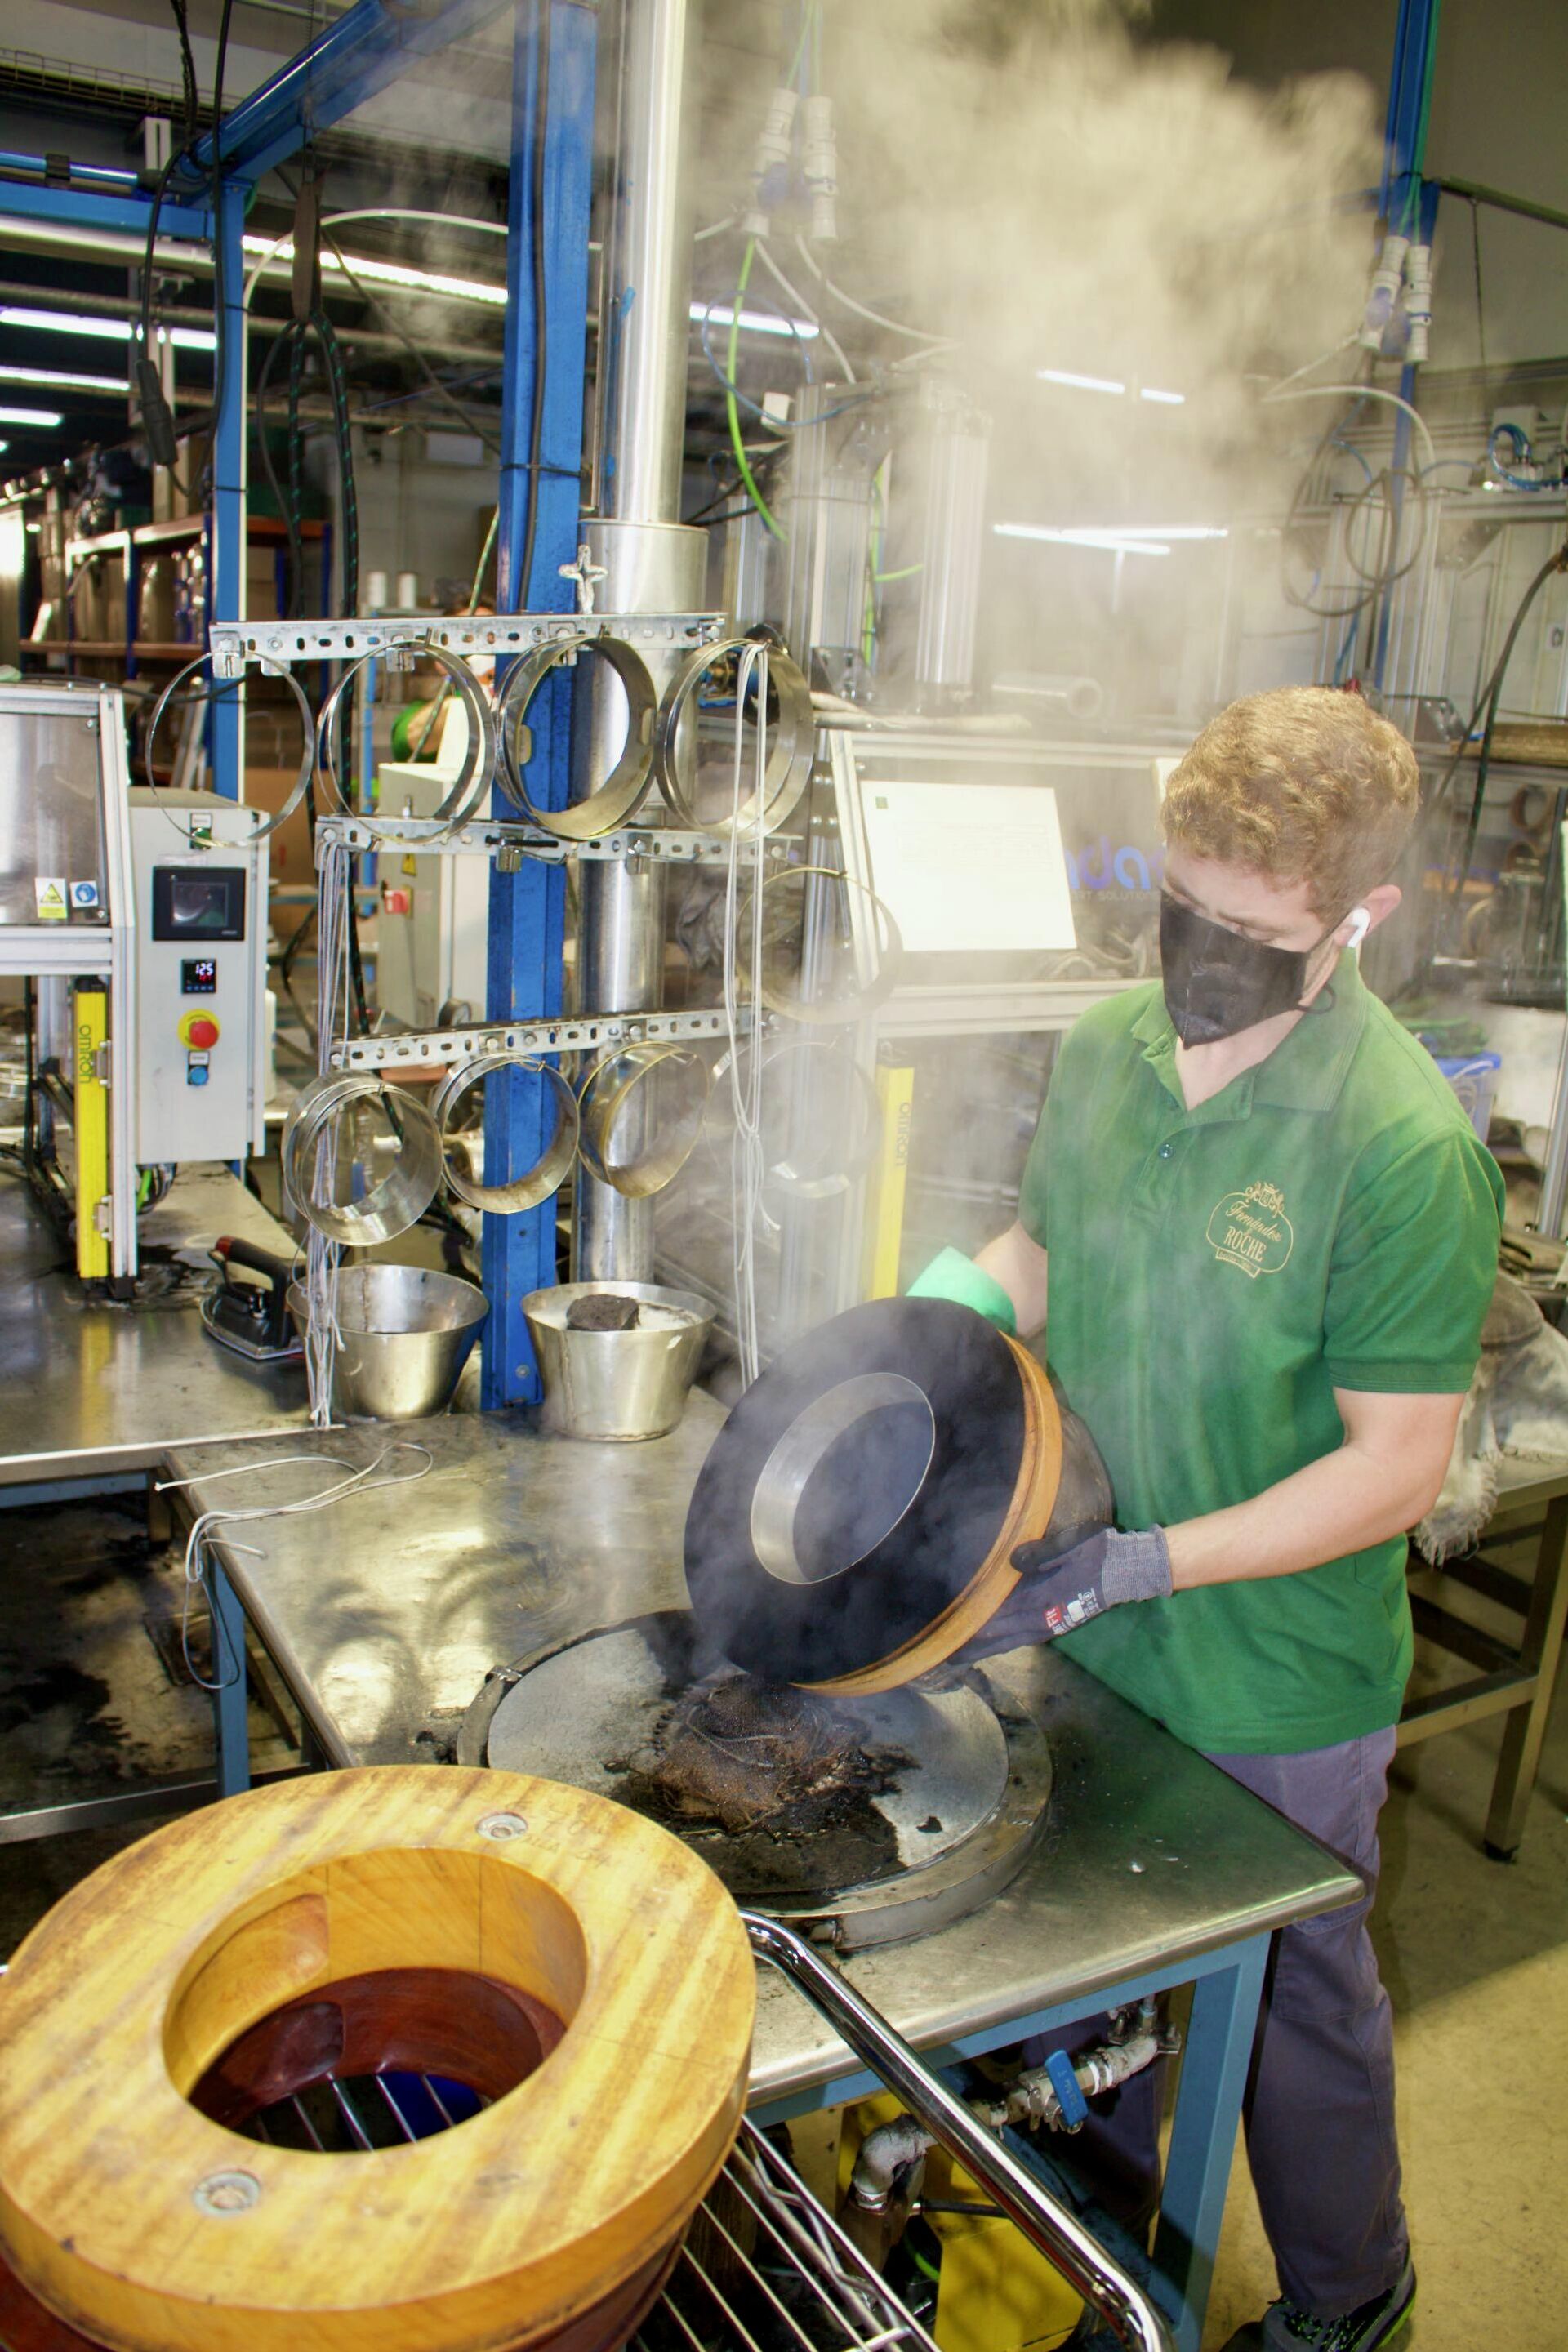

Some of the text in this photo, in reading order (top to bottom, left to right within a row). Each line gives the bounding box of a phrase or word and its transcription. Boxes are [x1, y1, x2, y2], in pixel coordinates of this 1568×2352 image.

[195, 963, 214, 976] 125
[79, 1024, 92, 1084] omron
[1223, 1225, 1267, 1263] ROCHE
